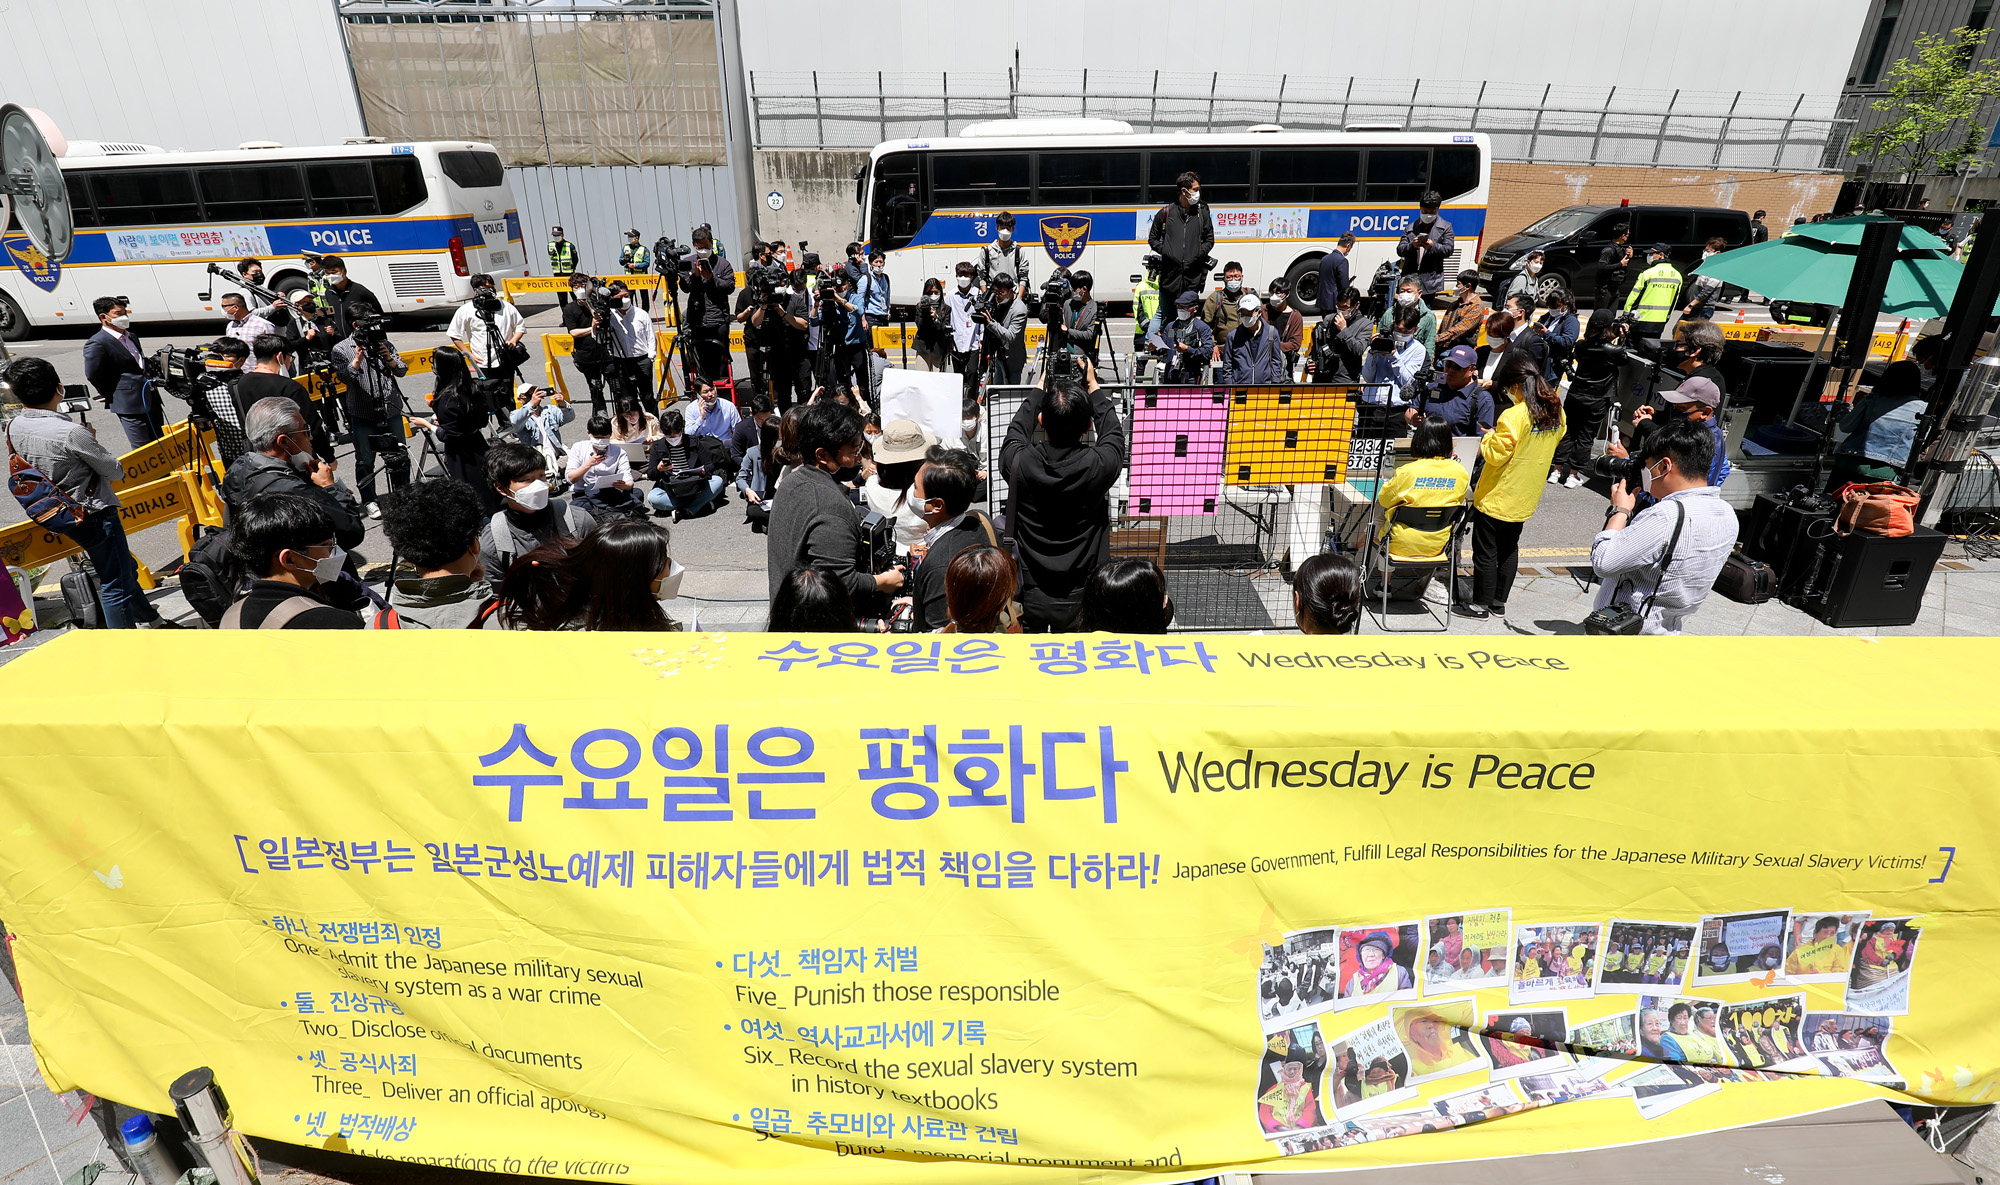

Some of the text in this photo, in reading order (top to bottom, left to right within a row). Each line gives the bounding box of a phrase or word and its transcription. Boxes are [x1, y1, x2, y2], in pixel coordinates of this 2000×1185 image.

[392, 146, 414, 154] 119-3
[483, 222, 504, 235] POLICE
[974, 221, 988, 237] 경
[1217, 212, 1262, 227] 일단멈춤!
[1350, 215, 1409, 232] POLICE
[118, 231, 223, 248] 사람이 보이면 일단멈춤!
[310, 229, 373, 247] POLICE
[1414, 477, 1457, 488] 반일행동
[119, 492, 180, 520] 지마시오
[758, 641, 1569, 675] 수요일은 평화다 Wednesday is Peace
[473, 723, 1595, 823] 수요일은 평화다 Wednesday is Peace
[424, 842, 634, 888] 일본군성노예제
[646, 850, 848, 889] 피해자들에게
[863, 849, 925, 886] 법적
[940, 851, 1036, 888] 책임을
[1049, 852, 1160, 889] 다하라!
[1172, 862, 1246, 881] Japanese
[1251, 849, 1338, 873] Government,
[1345, 844, 1381, 861] Fulfill
[1387, 843, 1426, 861] Legal
[1432, 843, 1547, 859] Responsibilities
[1554, 844, 1576, 858] for
[1582, 846, 1607, 860] the
[1611, 848, 1686, 864] Japanese
[1691, 851, 1749, 868] Military
[1753, 853, 1804, 867] Sexual
[1807, 854, 1863, 871] Slavery
[1869, 855, 1926, 869] Victims!
[318, 922, 400, 944] 전쟁범죄
[404, 927, 441, 949] 인정
[329, 949, 379, 969] Admit
[385, 951, 417, 969] the
[424, 954, 506, 976] Japanese
[514, 959, 580, 982] military
[587, 969, 643, 988] sexual
[798, 947, 867, 975] 책임자
[874, 946, 918, 972] 처벌
[338, 967, 600, 1006] slavery system as a war crime
[795, 981, 864, 1006] Punish
[873, 980, 932, 1002] those
[940, 979, 1059, 1005] responsible
[330, 991, 404, 1015] 진상규명
[352, 1020, 426, 1038] Disclose
[483, 1043, 582, 1070] documents
[797, 1020, 933, 1051] 역사교과서에
[942, 1020, 986, 1045] 기록
[340, 1052, 416, 1076] 공식사죄
[789, 1048, 858, 1076] Record
[864, 1059, 899, 1079] the
[907, 1053, 972, 1079] sexual
[981, 1053, 1054, 1077] slavery
[1062, 1059, 1137, 1078] system
[382, 1082, 443, 1101] Deliver
[449, 1089, 470, 1103] an
[477, 1086, 534, 1107] official
[792, 1074, 998, 1110] in history textbooks
[338, 1113, 417, 1141] 법적배상
[807, 1112, 895, 1142] 추모비와
[902, 1115, 968, 1140] 사료관
[975, 1126, 1018, 1145] 건립
[503, 1156, 520, 1174] to
[528, 1156, 558, 1175] the
